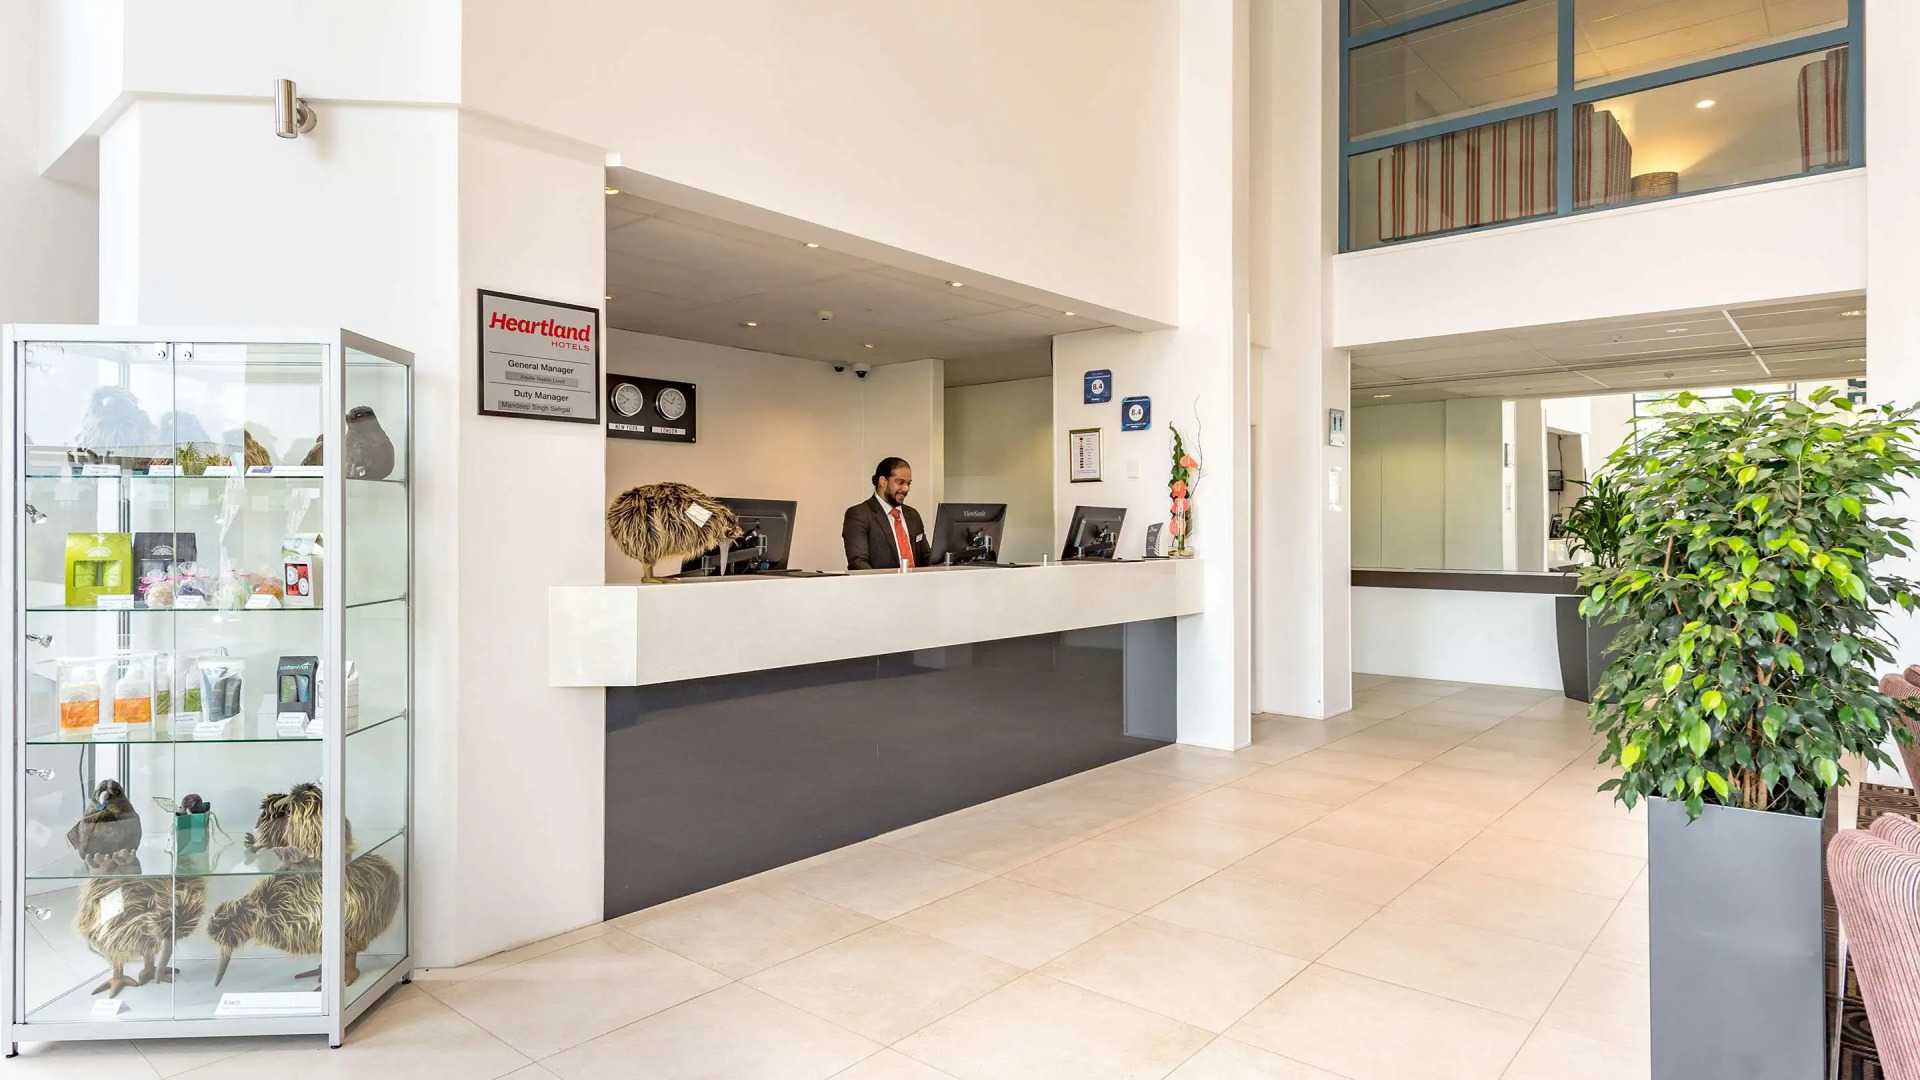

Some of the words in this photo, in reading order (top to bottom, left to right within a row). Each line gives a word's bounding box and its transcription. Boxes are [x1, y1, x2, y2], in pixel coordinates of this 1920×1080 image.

[489, 311, 591, 342] Heartland
[551, 340, 591, 352] HOTELS
[508, 360, 539, 370] General
[541, 362, 574, 375] Manager
[514, 389, 533, 399] Duty
[534, 391, 569, 402] Manager
[501, 401, 530, 410] Mandeep
[531, 403, 549, 412] Singh
[550, 405, 571, 414] Sehgal
[1131, 408, 1142, 416] 8.4
